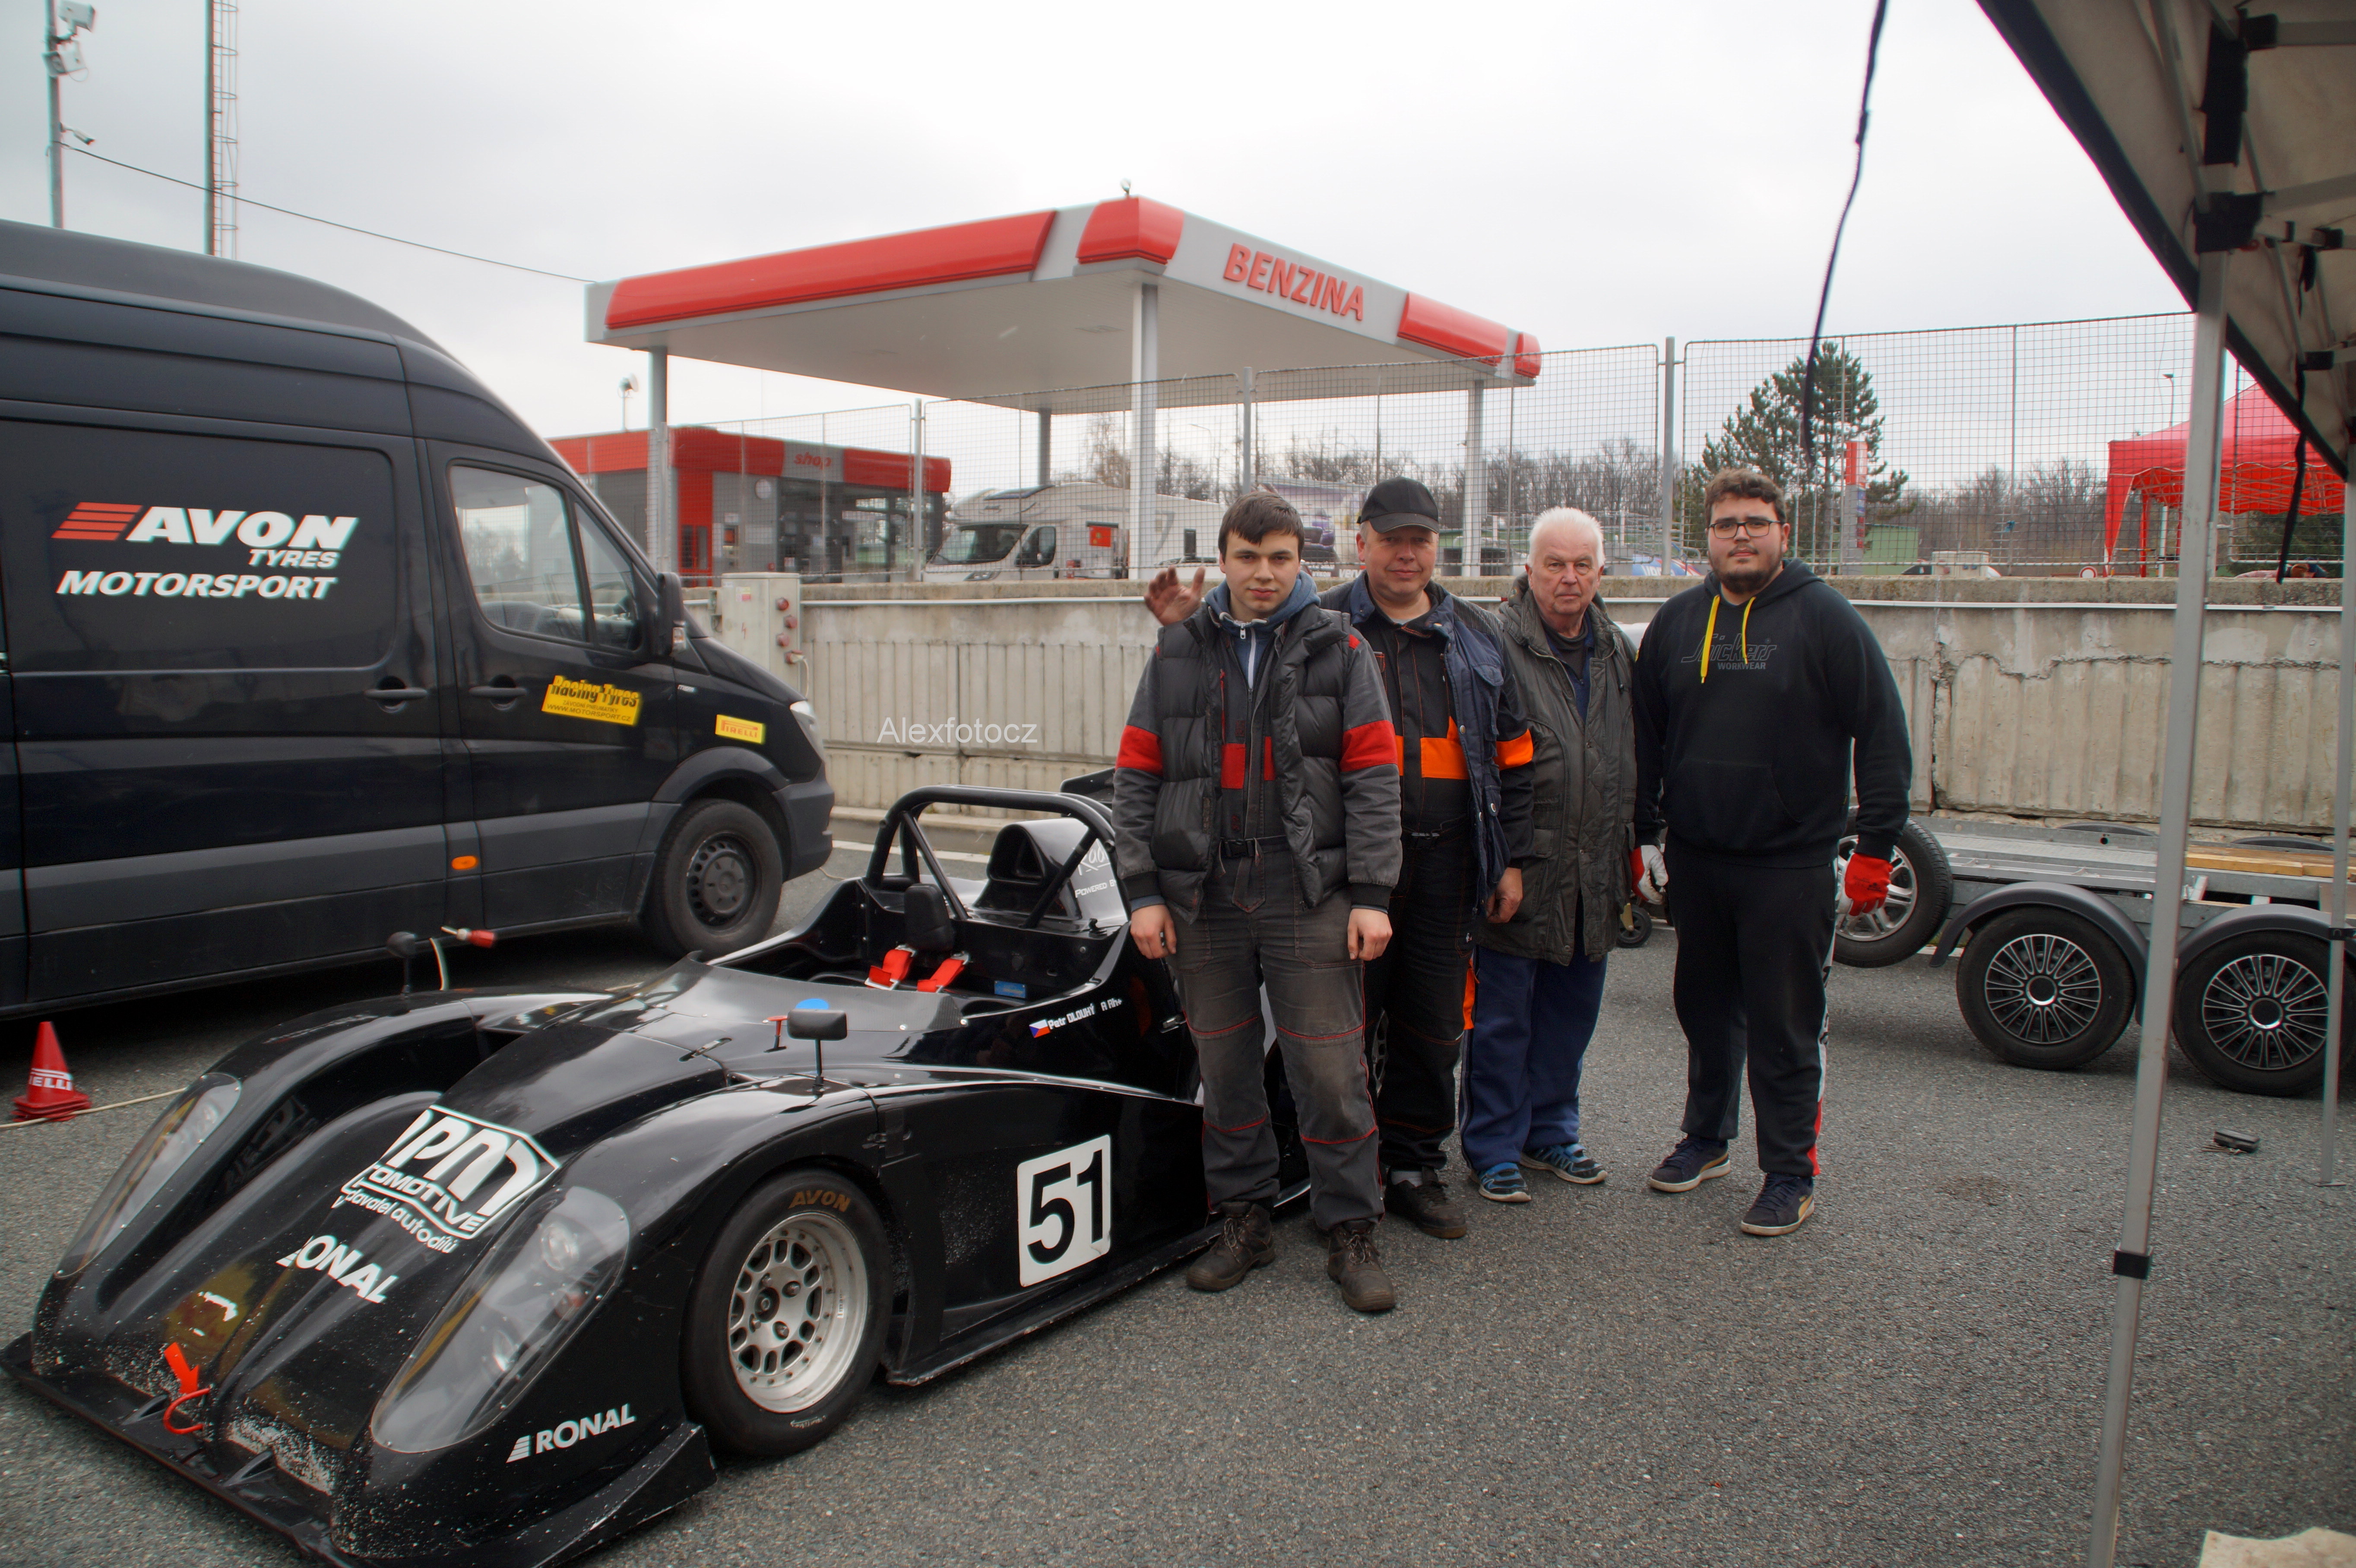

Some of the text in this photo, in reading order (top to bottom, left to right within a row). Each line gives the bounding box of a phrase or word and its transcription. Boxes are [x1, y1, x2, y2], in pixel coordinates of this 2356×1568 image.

[1223, 243, 1364, 322] BENZINA
[794, 451, 832, 471] shop
[125, 506, 358, 550] AVON
[248, 549, 340, 569] TYRES
[56, 570, 338, 600] MOTORSPORT
[1717, 662, 1766, 670] WORKWEAR
[550, 675, 640, 707] Racing Tyres
[546, 703, 631, 722] WWW.MOTORSPORT.CZ
[586, 703, 619, 713] PNEUMATIKY
[720, 719, 758, 738] PIRELLI
[1048, 1017, 1066, 1030] Petr
[1066, 1003, 1096, 1024] DLOUHÝ
[787, 1189, 852, 1213] AVON
[1026, 1148, 1103, 1265] 51
[295, 1235, 399, 1304] ONAL
[535, 1403, 636, 1455] RONAL
